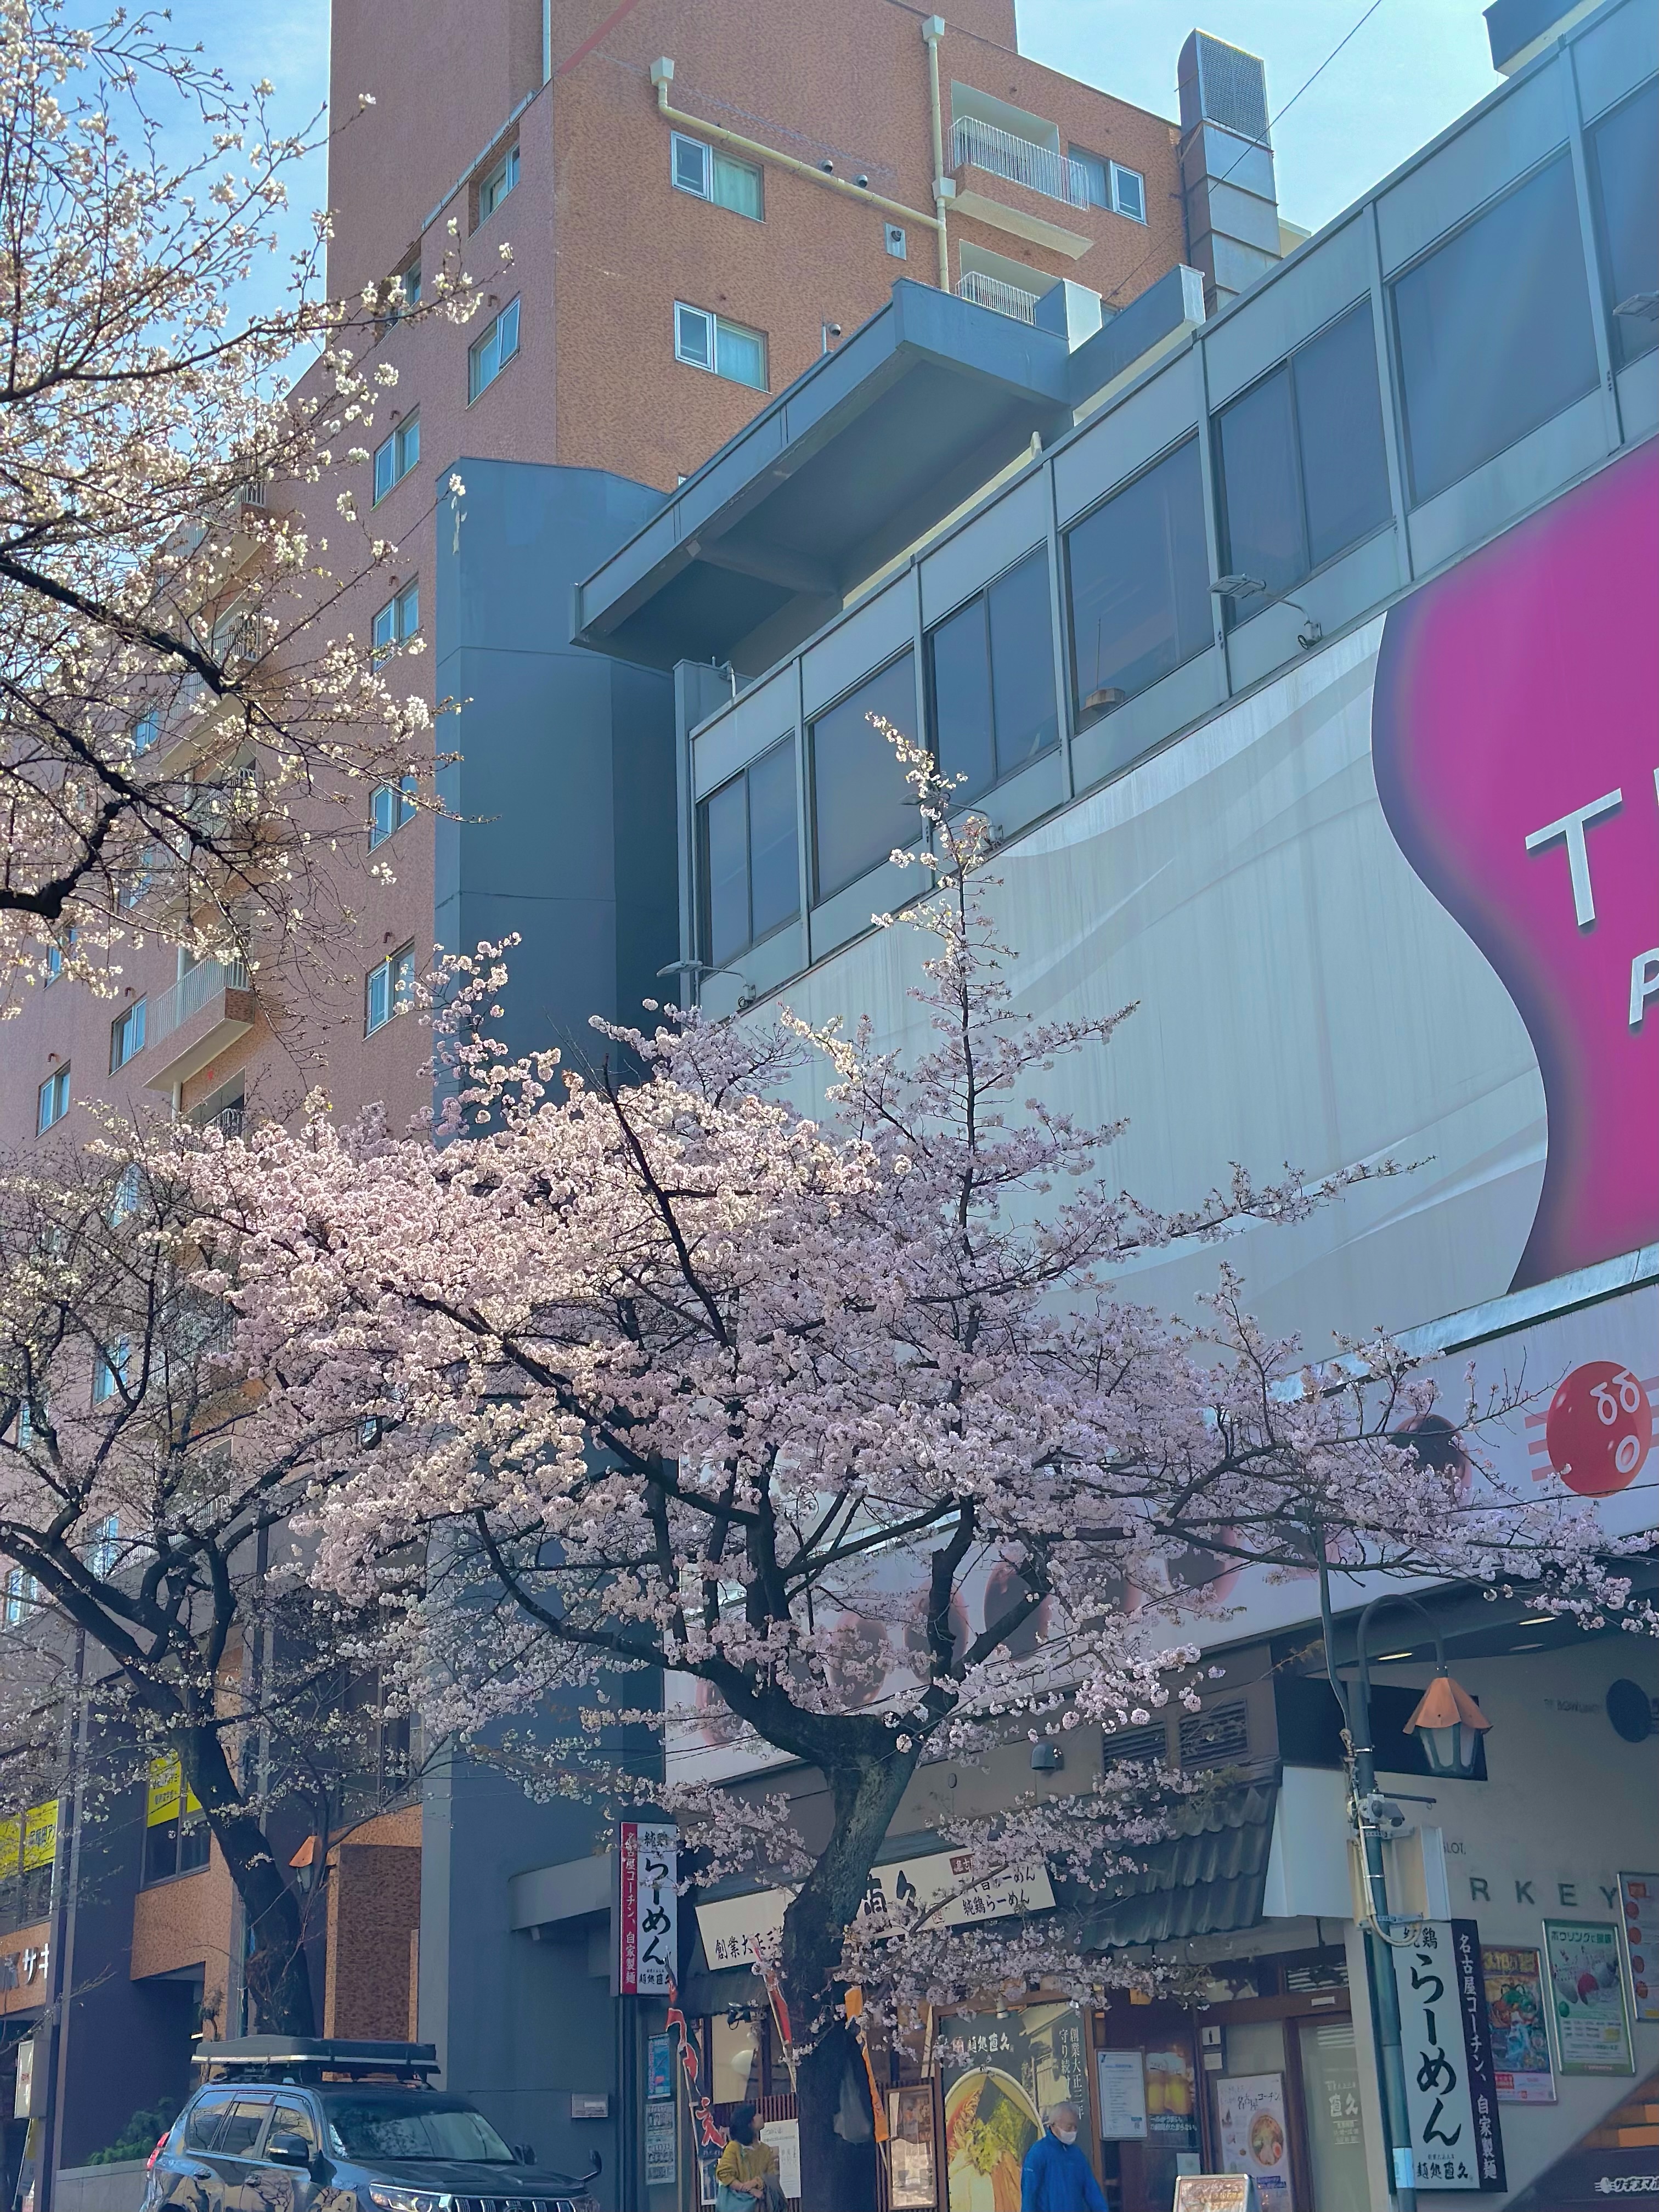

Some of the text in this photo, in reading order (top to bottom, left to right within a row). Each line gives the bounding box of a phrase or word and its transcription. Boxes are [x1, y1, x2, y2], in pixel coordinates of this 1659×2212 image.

[642, 1858, 671, 1965] らーめん
[1410, 1953, 1462, 2146] らーめん
